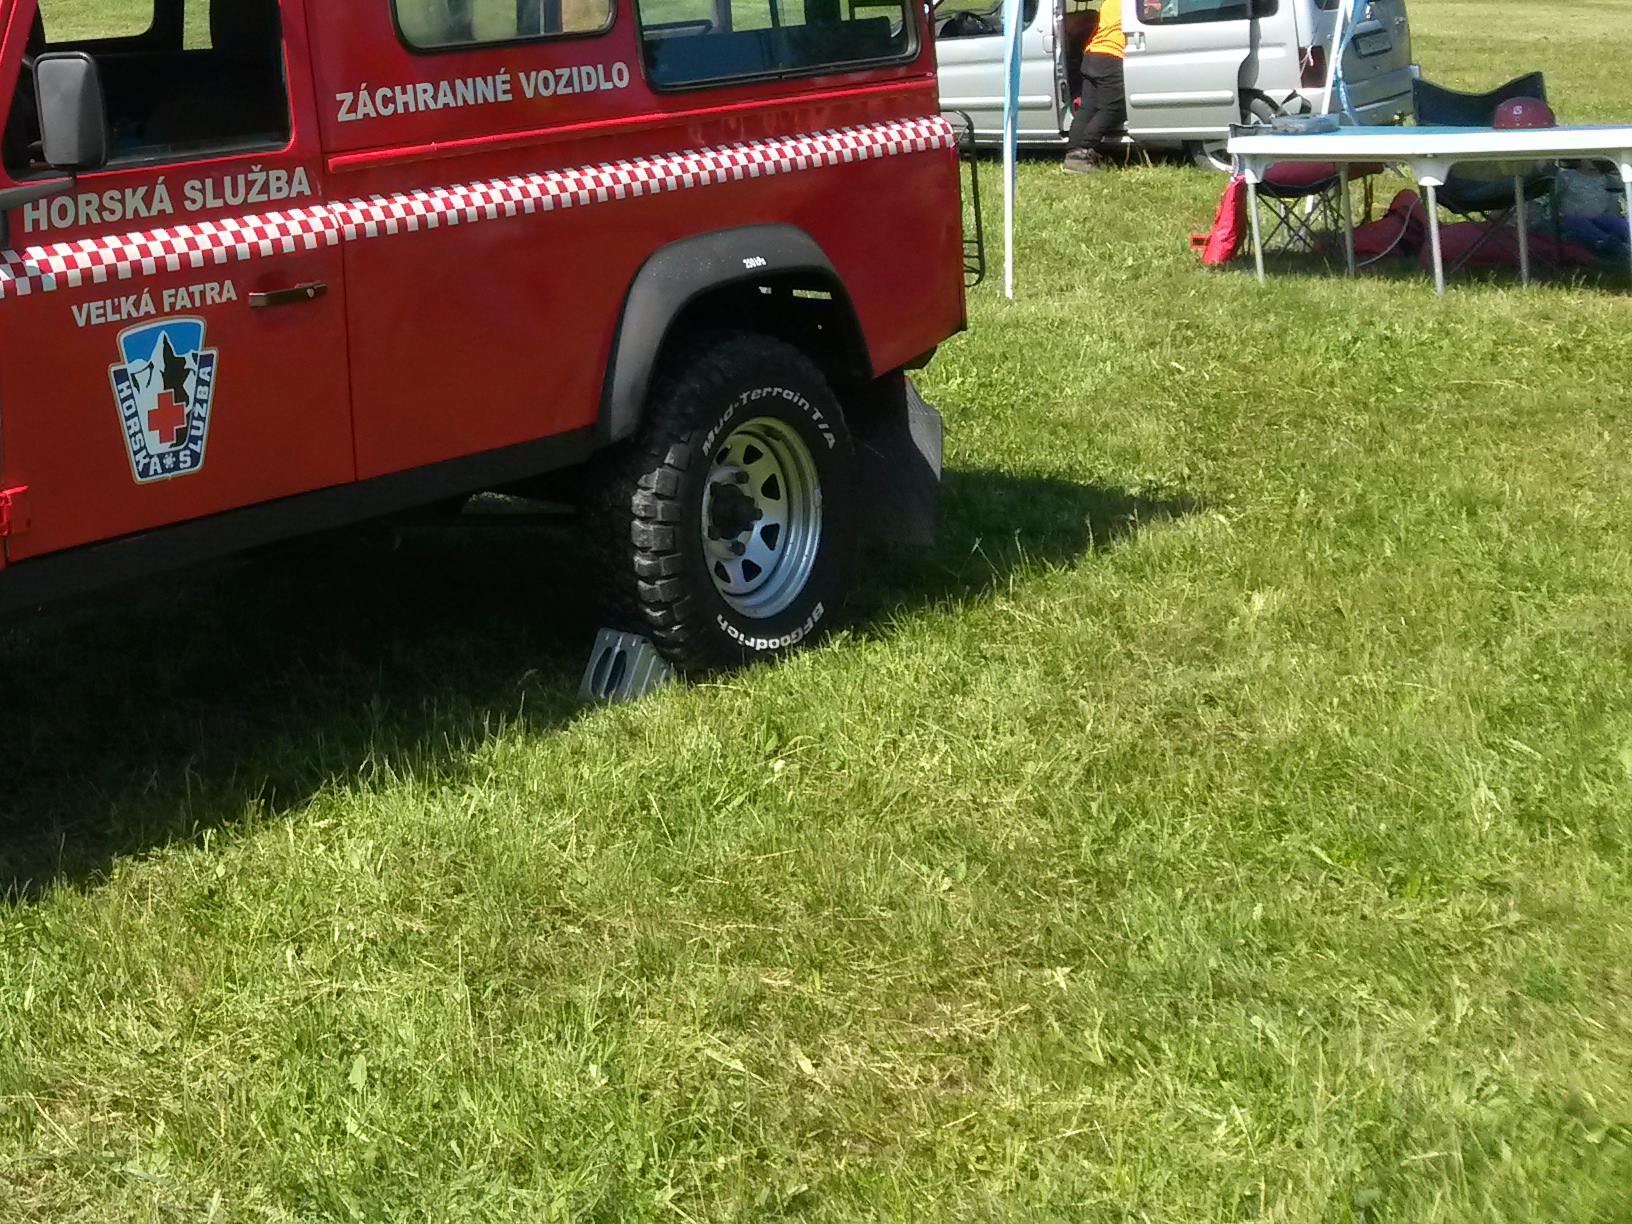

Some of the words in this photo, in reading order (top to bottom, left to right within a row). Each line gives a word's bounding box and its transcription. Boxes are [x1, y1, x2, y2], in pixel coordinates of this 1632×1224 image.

[335, 67, 511, 123] ZÁCHRANNÉ
[518, 62, 630, 99] VOZIDLO
[23, 176, 174, 234] HORSKÁ
[182, 166, 312, 213] SLUŽBA
[71, 287, 156, 327] VEĽKÁ
[163, 279, 238, 313] FATRA
[716, 601, 826, 652] BFGoodrich
